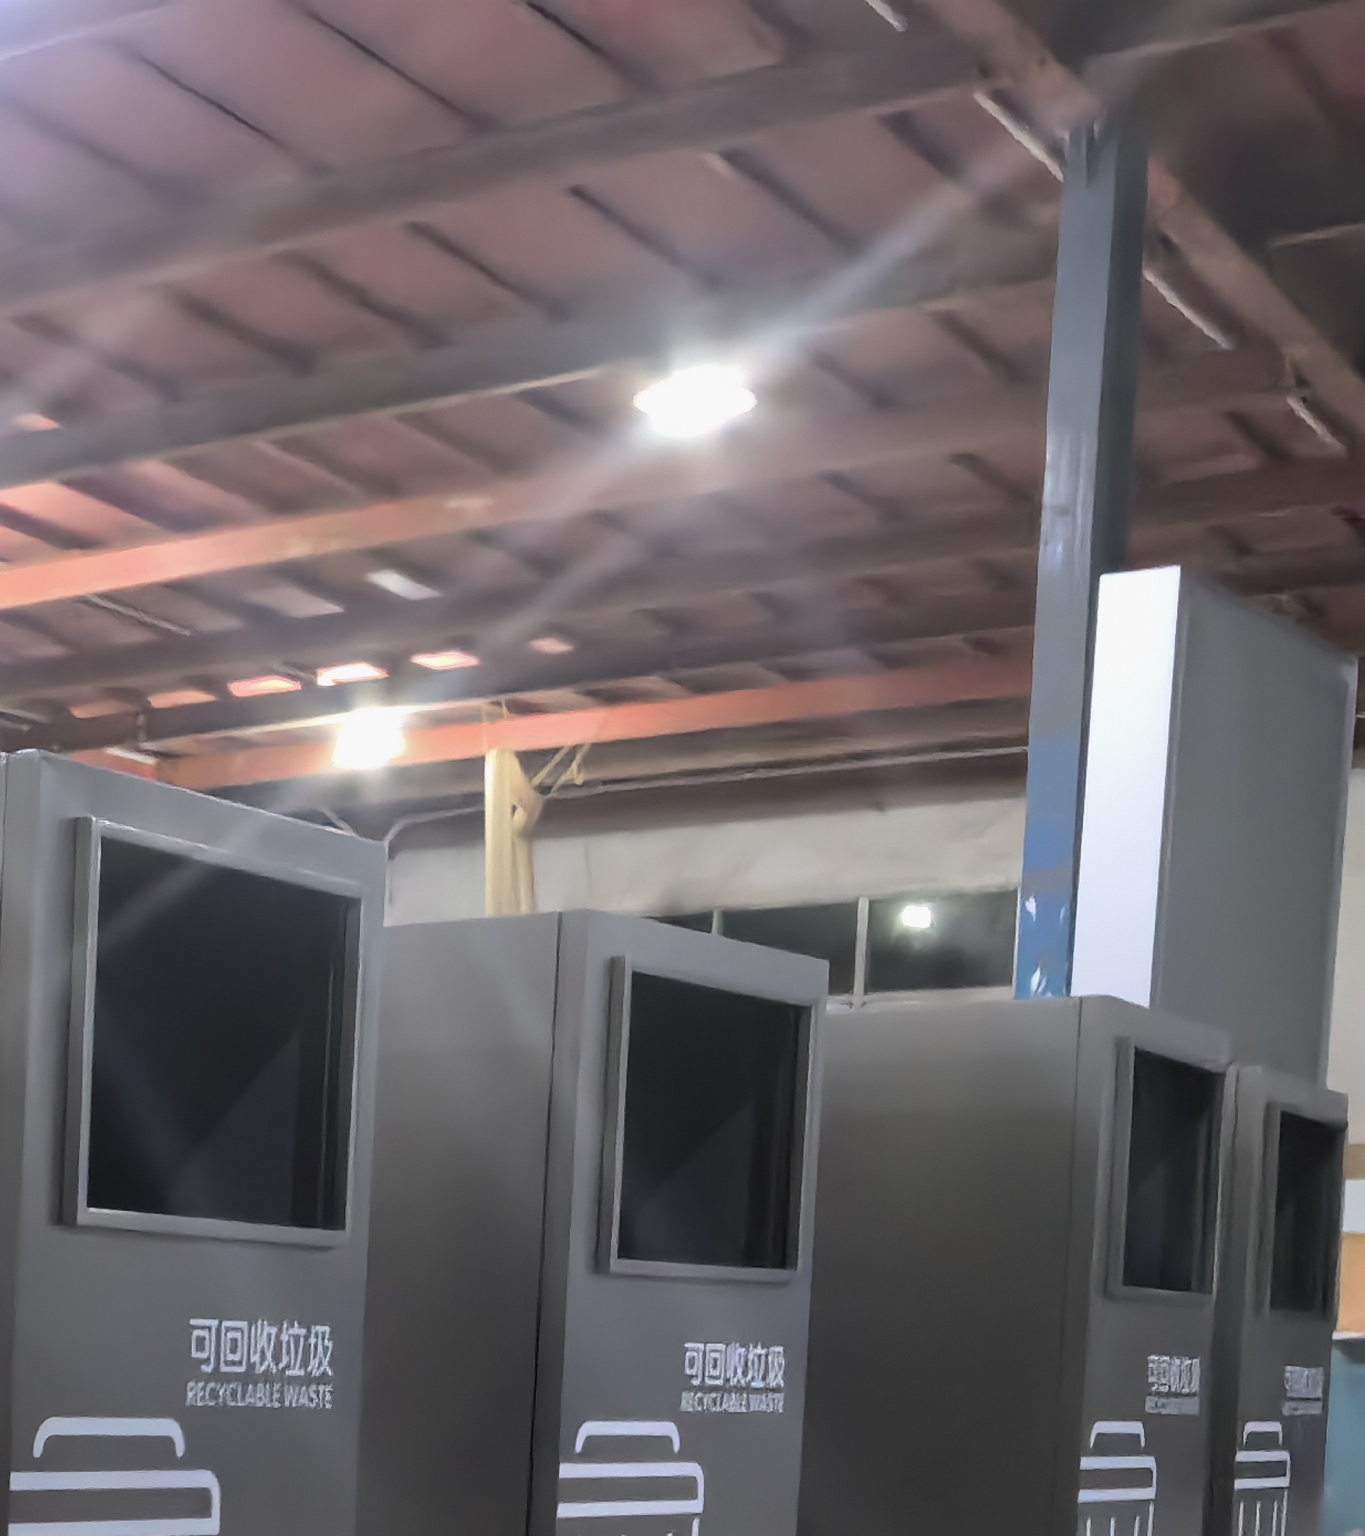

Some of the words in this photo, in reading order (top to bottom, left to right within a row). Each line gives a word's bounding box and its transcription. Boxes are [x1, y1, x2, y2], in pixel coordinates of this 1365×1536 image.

[188, 1318, 334, 1378] 可回收垃圾
[185, 1380, 282, 1410] RECYCLABLE
[283, 1382, 334, 1410] WASTE
